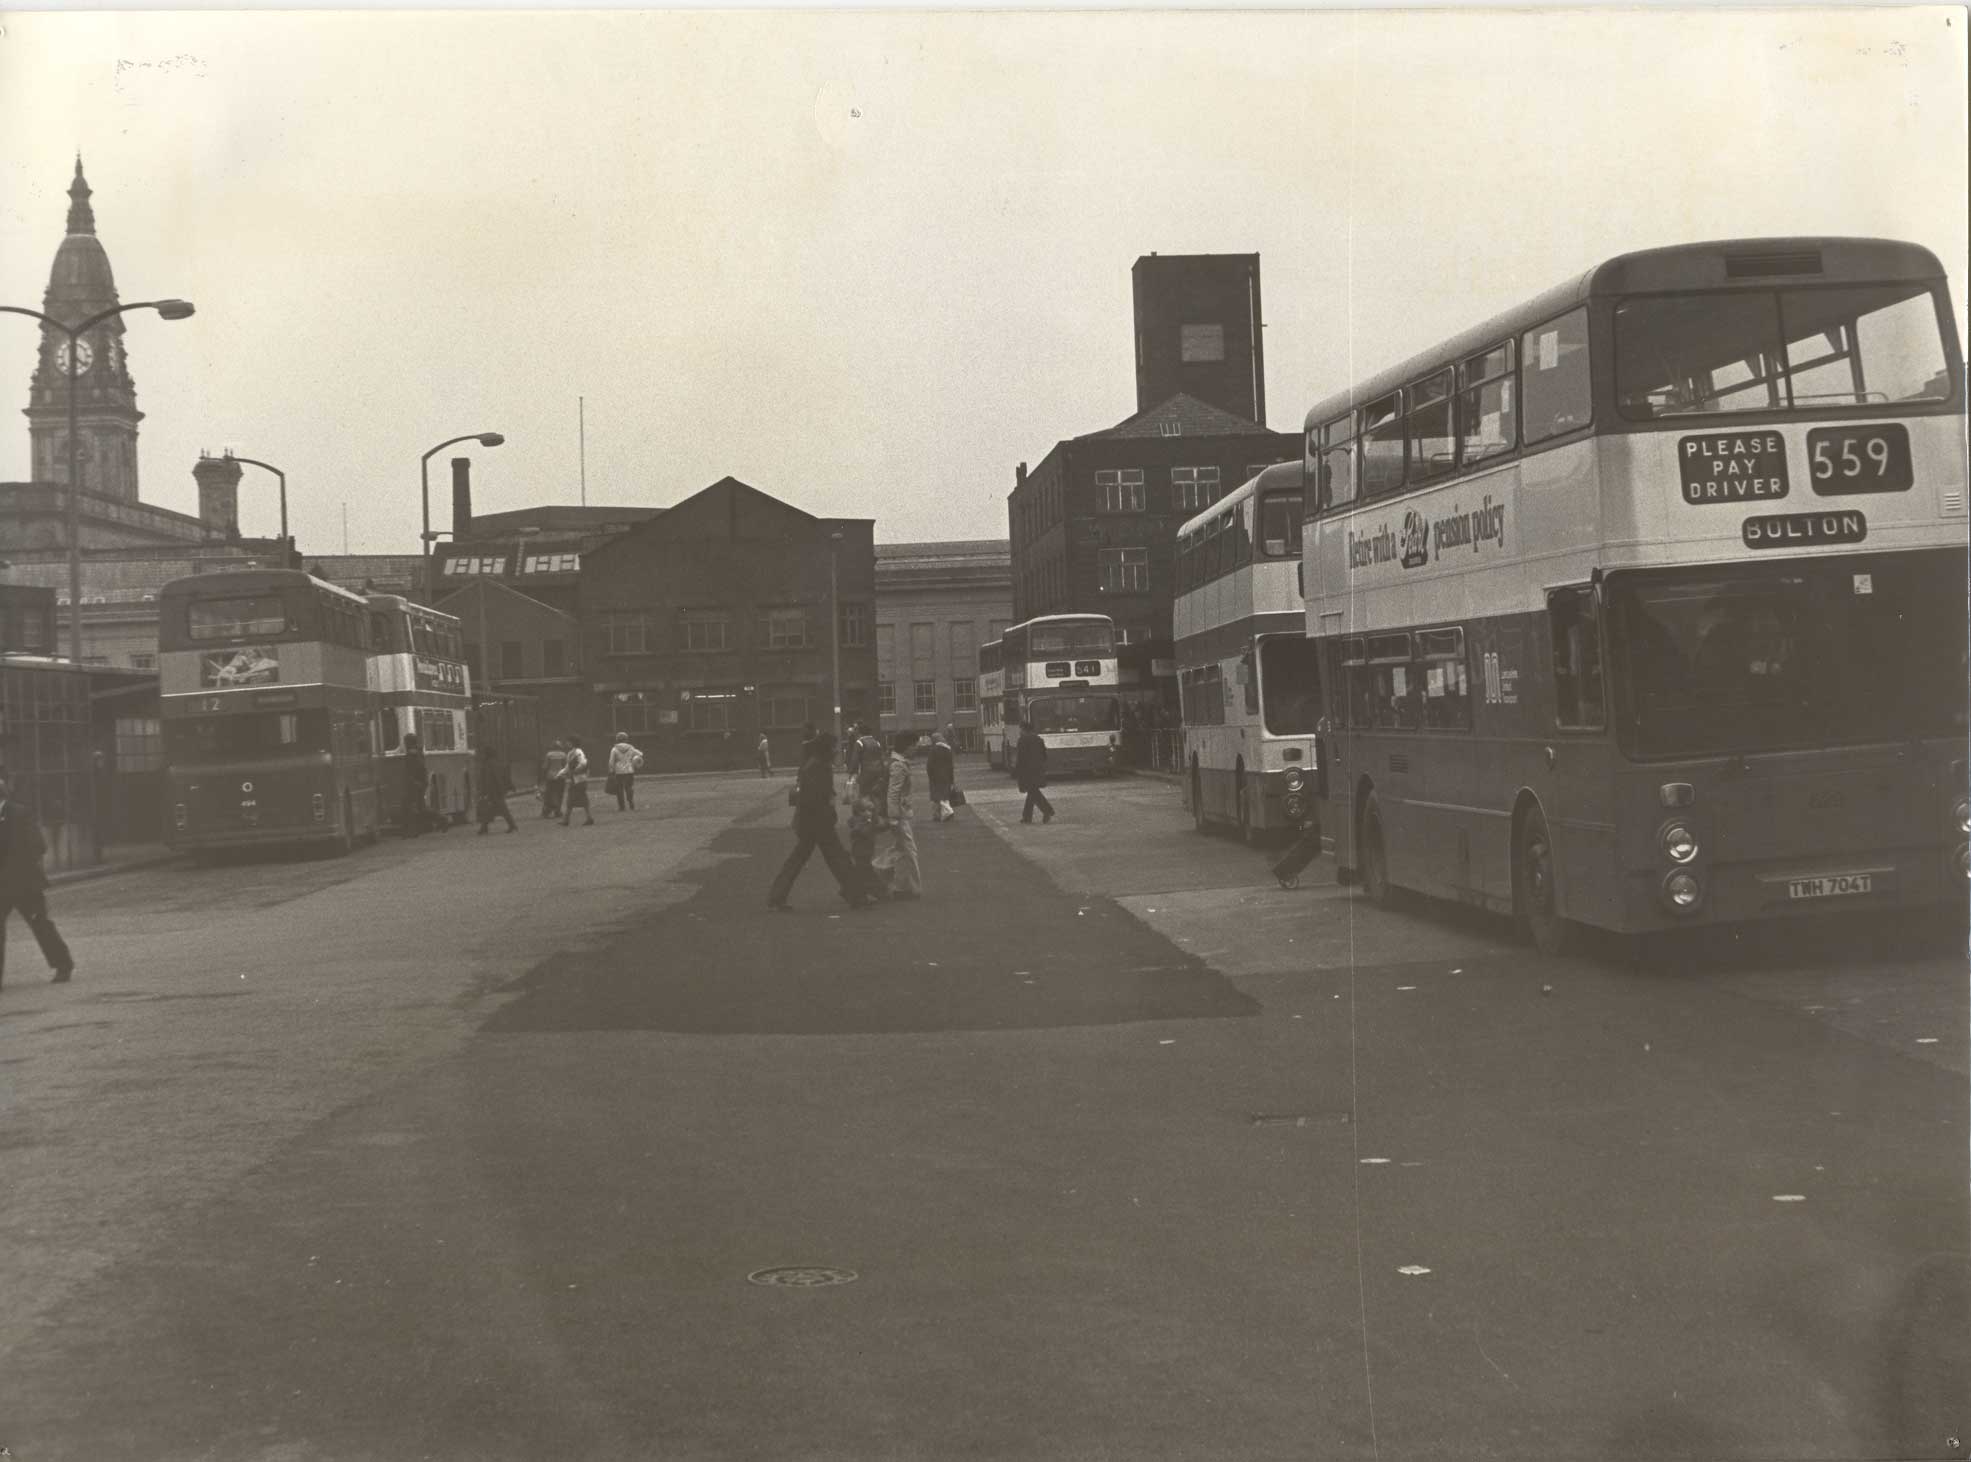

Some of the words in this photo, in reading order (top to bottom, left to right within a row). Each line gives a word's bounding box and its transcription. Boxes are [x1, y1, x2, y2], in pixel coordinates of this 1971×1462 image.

[1686, 436, 1778, 458] PLEASE
[1813, 437, 1889, 479] 559
[1712, 458, 1756, 476] PAY
[1689, 477, 1782, 499] DRIVER
[1349, 529, 1372, 569] Retire
[1372, 522, 1391, 564] with
[1434, 503, 1472, 562] pension
[1472, 494, 1505, 553] policy
[1746, 516, 1860, 540] BOLTON
[1791, 879, 1824, 897] TWH
[1827, 875, 1871, 894] 704T
